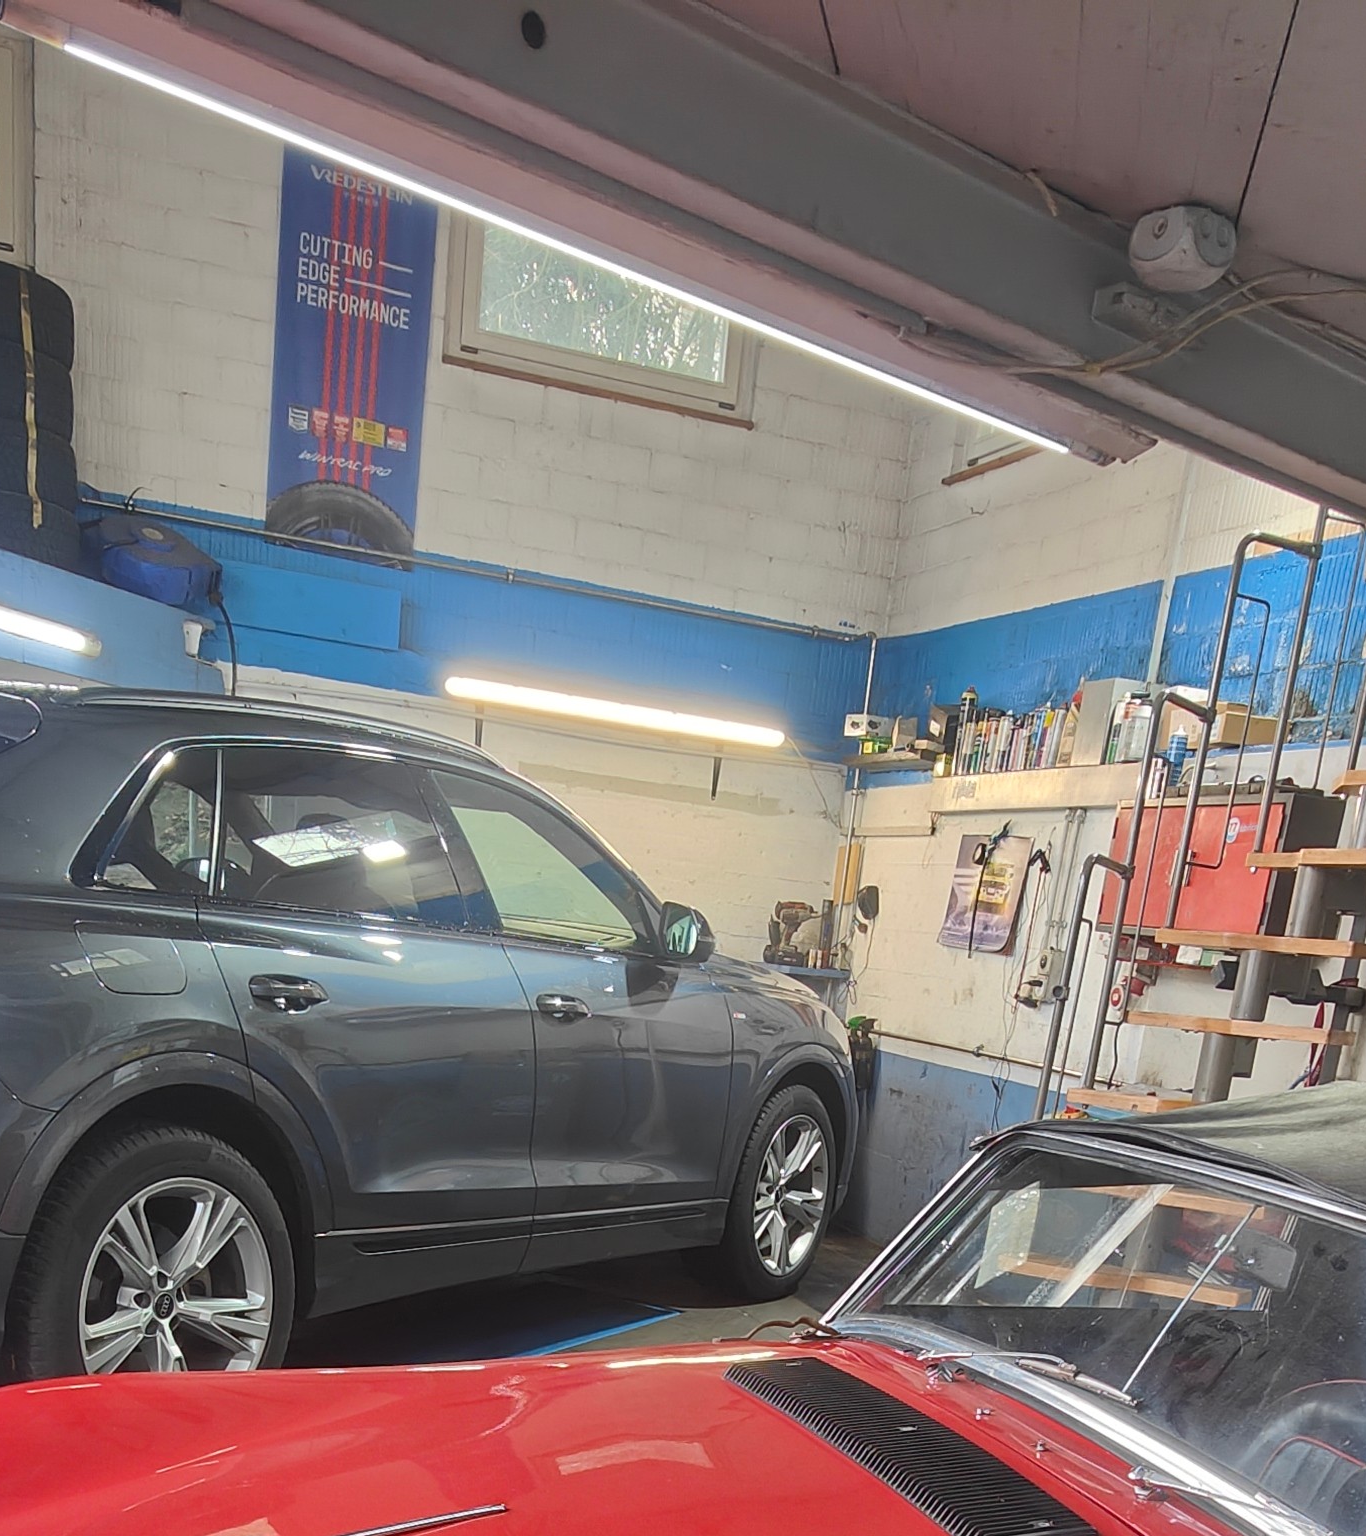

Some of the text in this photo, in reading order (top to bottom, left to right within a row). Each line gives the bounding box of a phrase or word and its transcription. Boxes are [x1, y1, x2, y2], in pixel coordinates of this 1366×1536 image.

[310, 164, 414, 206] VREDESTEIN
[299, 231, 373, 269] CUTTING
[297, 257, 341, 287] EDGE
[296, 281, 410, 330] PERFORMANCE
[298, 450, 392, 477] WINTRAC PRO
